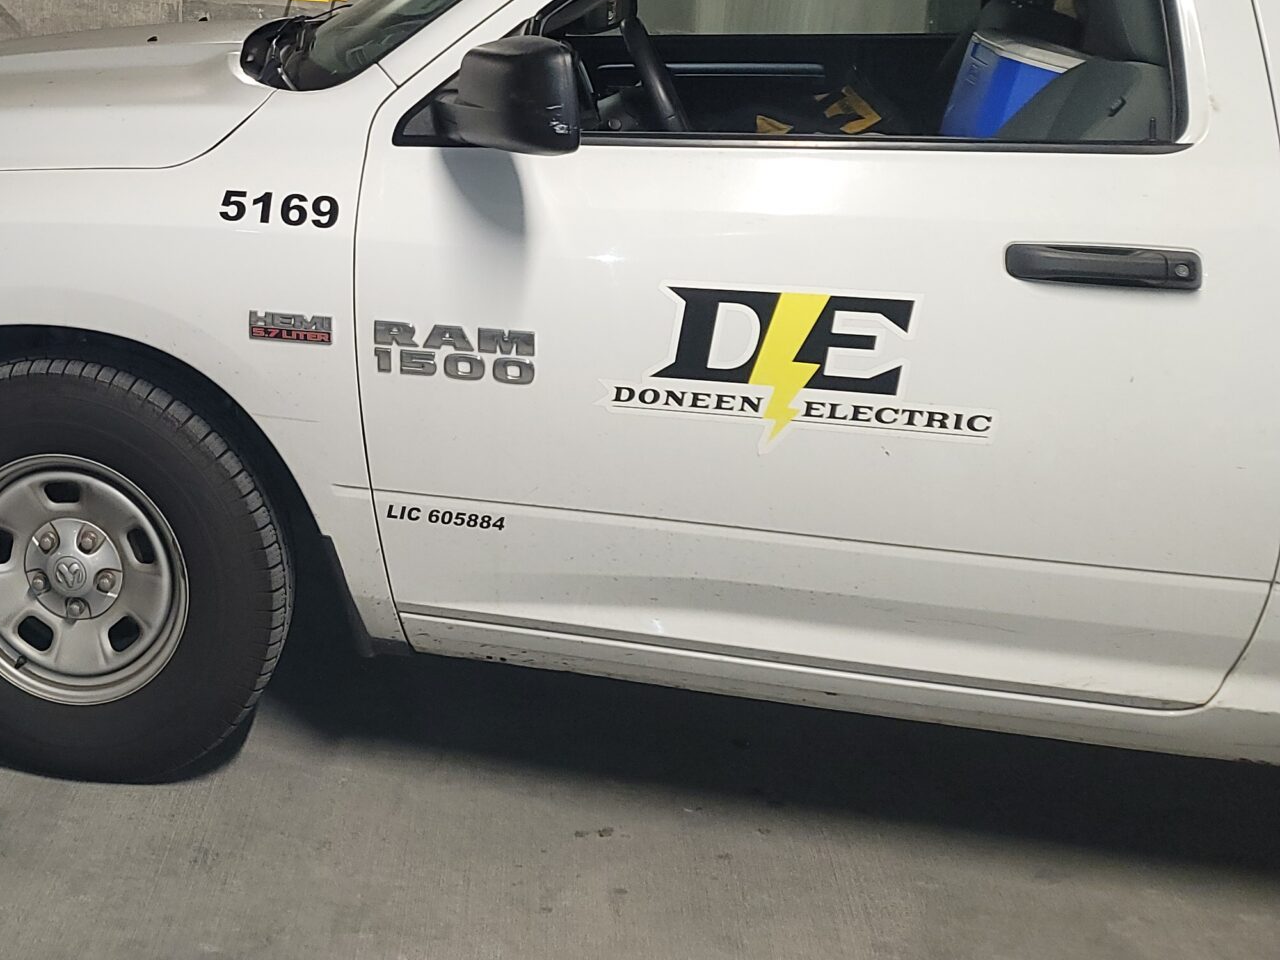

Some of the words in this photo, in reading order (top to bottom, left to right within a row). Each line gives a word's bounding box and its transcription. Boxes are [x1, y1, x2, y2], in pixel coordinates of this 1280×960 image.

[219, 189, 340, 229] 5169
[248, 310, 332, 332] HEMI
[252, 327, 280, 338] 5.7
[281, 330, 330, 342] LITER
[373, 319, 536, 357] RAM
[374, 347, 536, 386] 1500
[611, 385, 765, 414] DONEEN
[803, 400, 993, 433] ELECTRIC
[386, 504, 421, 522] LIC
[427, 509, 506, 531] 605884
